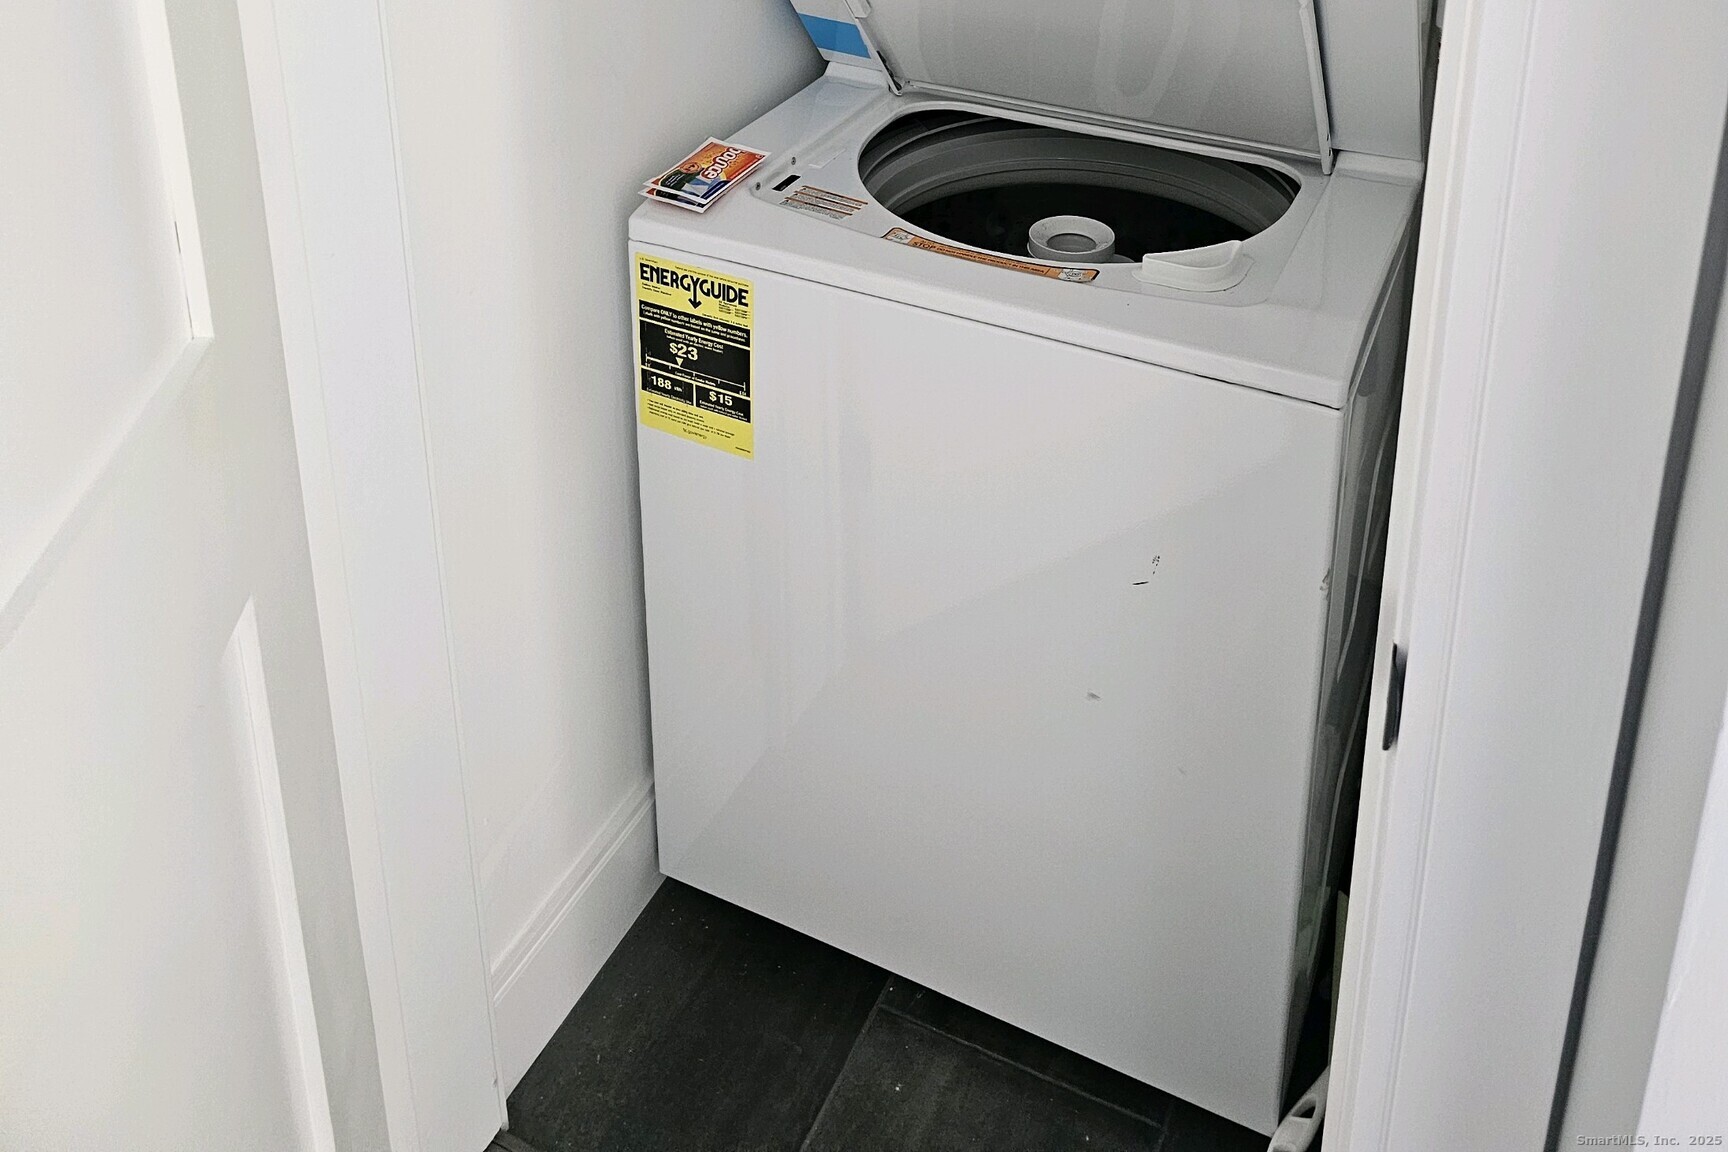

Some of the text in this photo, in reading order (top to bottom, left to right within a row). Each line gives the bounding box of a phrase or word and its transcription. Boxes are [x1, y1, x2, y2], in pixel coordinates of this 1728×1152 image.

[913, 241, 936, 250] STOP
[639, 262, 749, 309] ENERGYGUIDE
[641, 304, 659, 314] Compare
[689, 317, 702, 325] labels
[713, 324, 726, 332] yellow
[664, 328, 684, 338] Estimated
[685, 334, 697, 343] Yearly
[698, 338, 712, 347] Energy
[669, 342, 698, 361] $23
[651, 375, 672, 390] 188
[709, 391, 732, 406] $15
